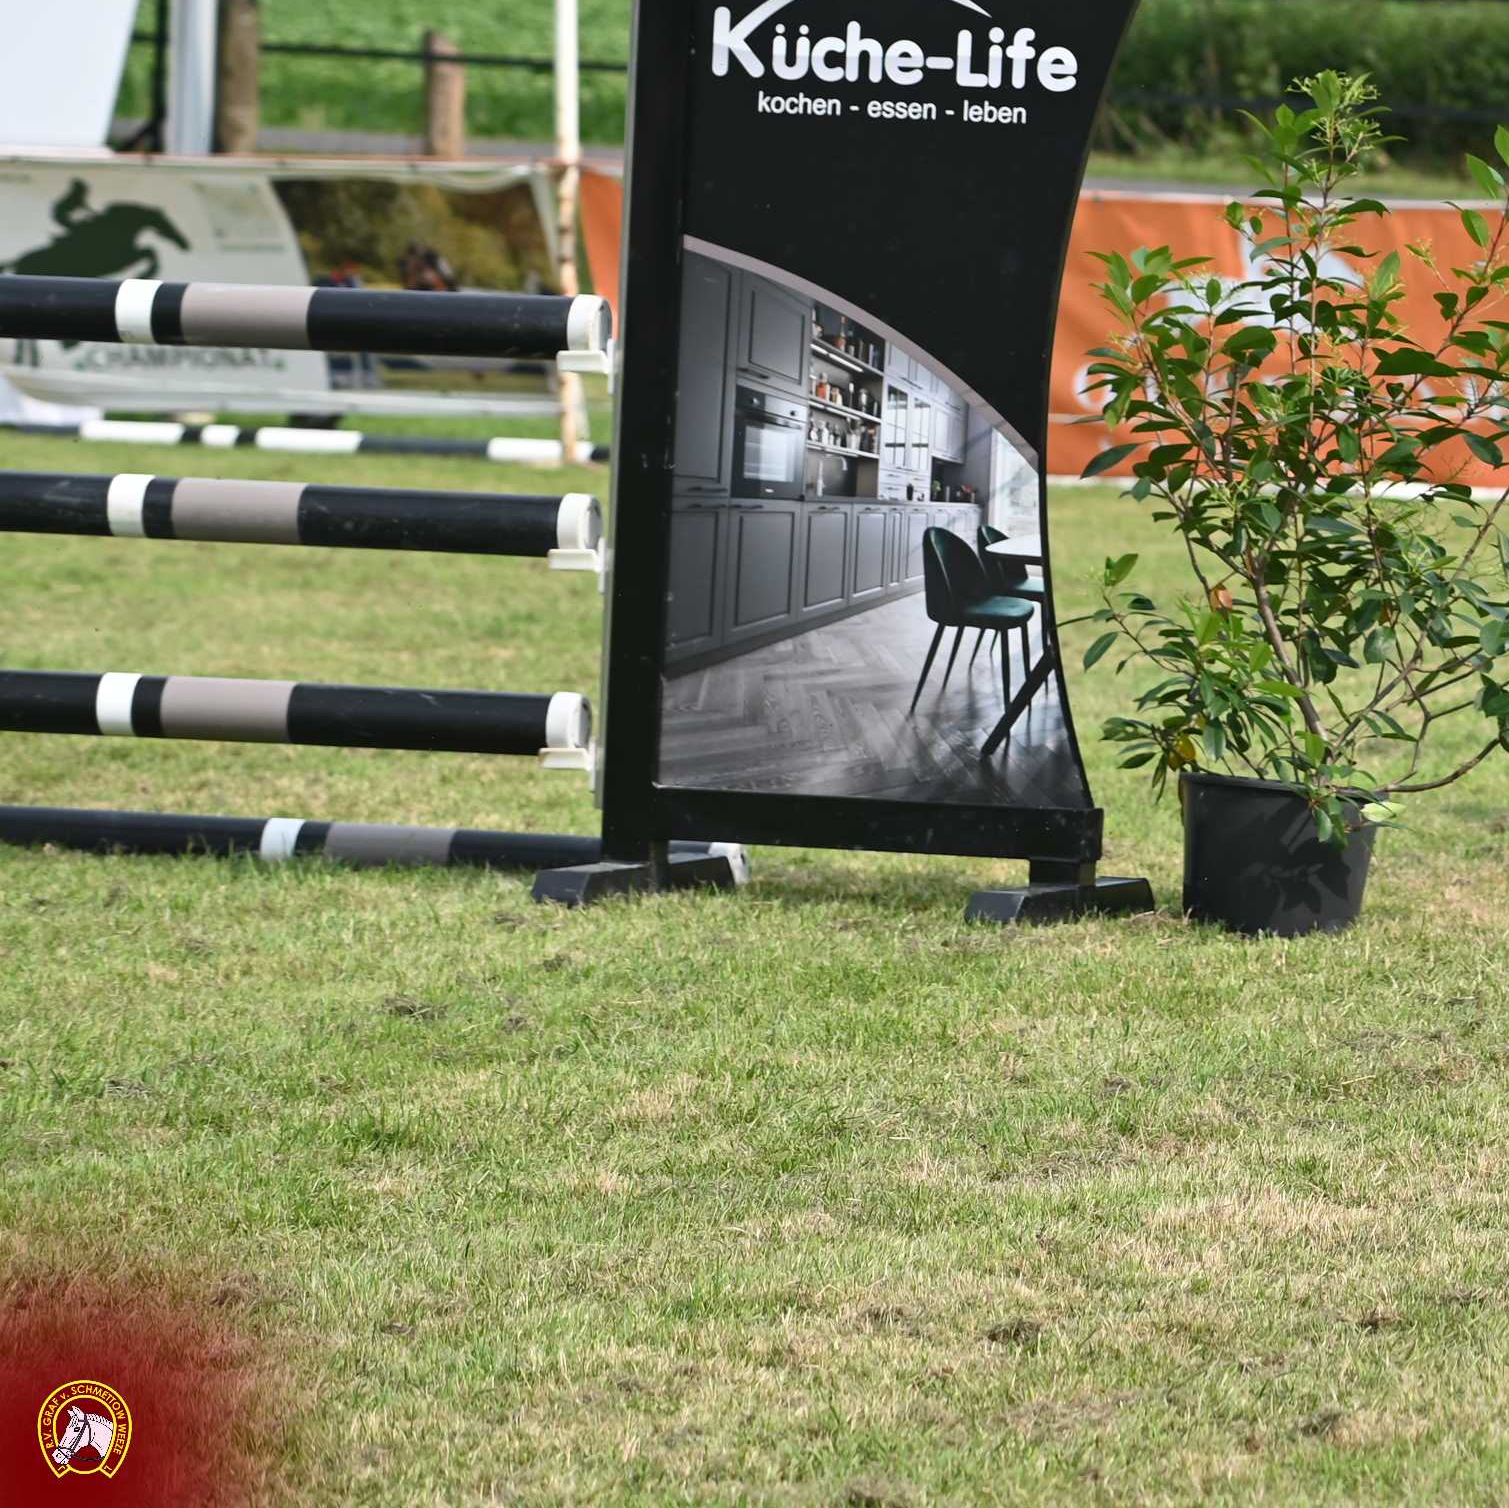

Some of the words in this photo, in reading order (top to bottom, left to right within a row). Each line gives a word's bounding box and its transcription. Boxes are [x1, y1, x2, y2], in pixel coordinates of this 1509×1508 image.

[711, 6, 1078, 92] Küche-Life
[758, 91, 841, 116] kochen
[867, 99, 936, 120] essen
[962, 100, 1027, 124] leben
